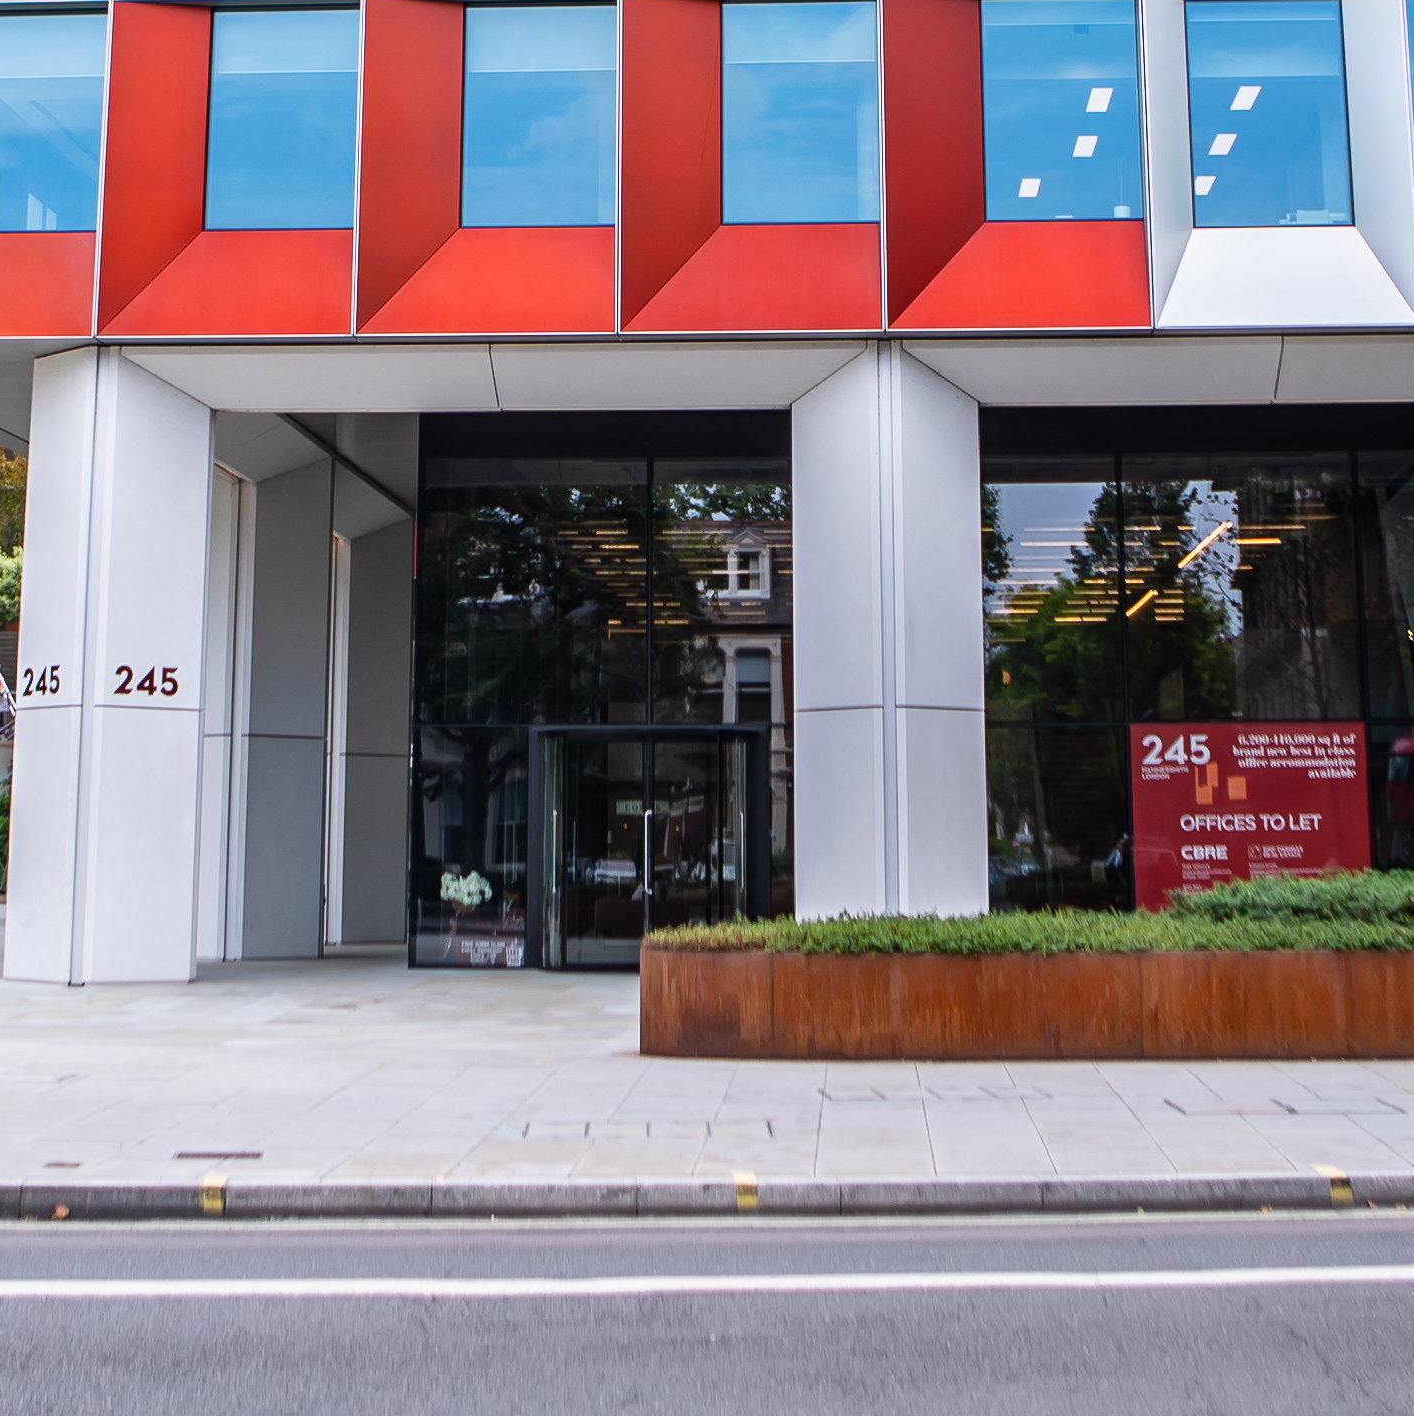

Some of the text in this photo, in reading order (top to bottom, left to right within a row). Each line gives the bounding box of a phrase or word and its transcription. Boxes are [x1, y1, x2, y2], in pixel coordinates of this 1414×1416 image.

[23, 665, 61, 697] 245
[114, 665, 179, 696] 245
[1317, 735, 1330, 746] sq
[1342, 733, 1356, 745] of
[1141, 733, 1212, 766] 245
[1232, 745, 1356, 757] brand new best in class
[1237, 757, 1269, 768] office
[1307, 768, 1357, 779] available
[1180, 813, 1323, 832] OFFICES TO LET
[1181, 844, 1229, 861] CBRE
